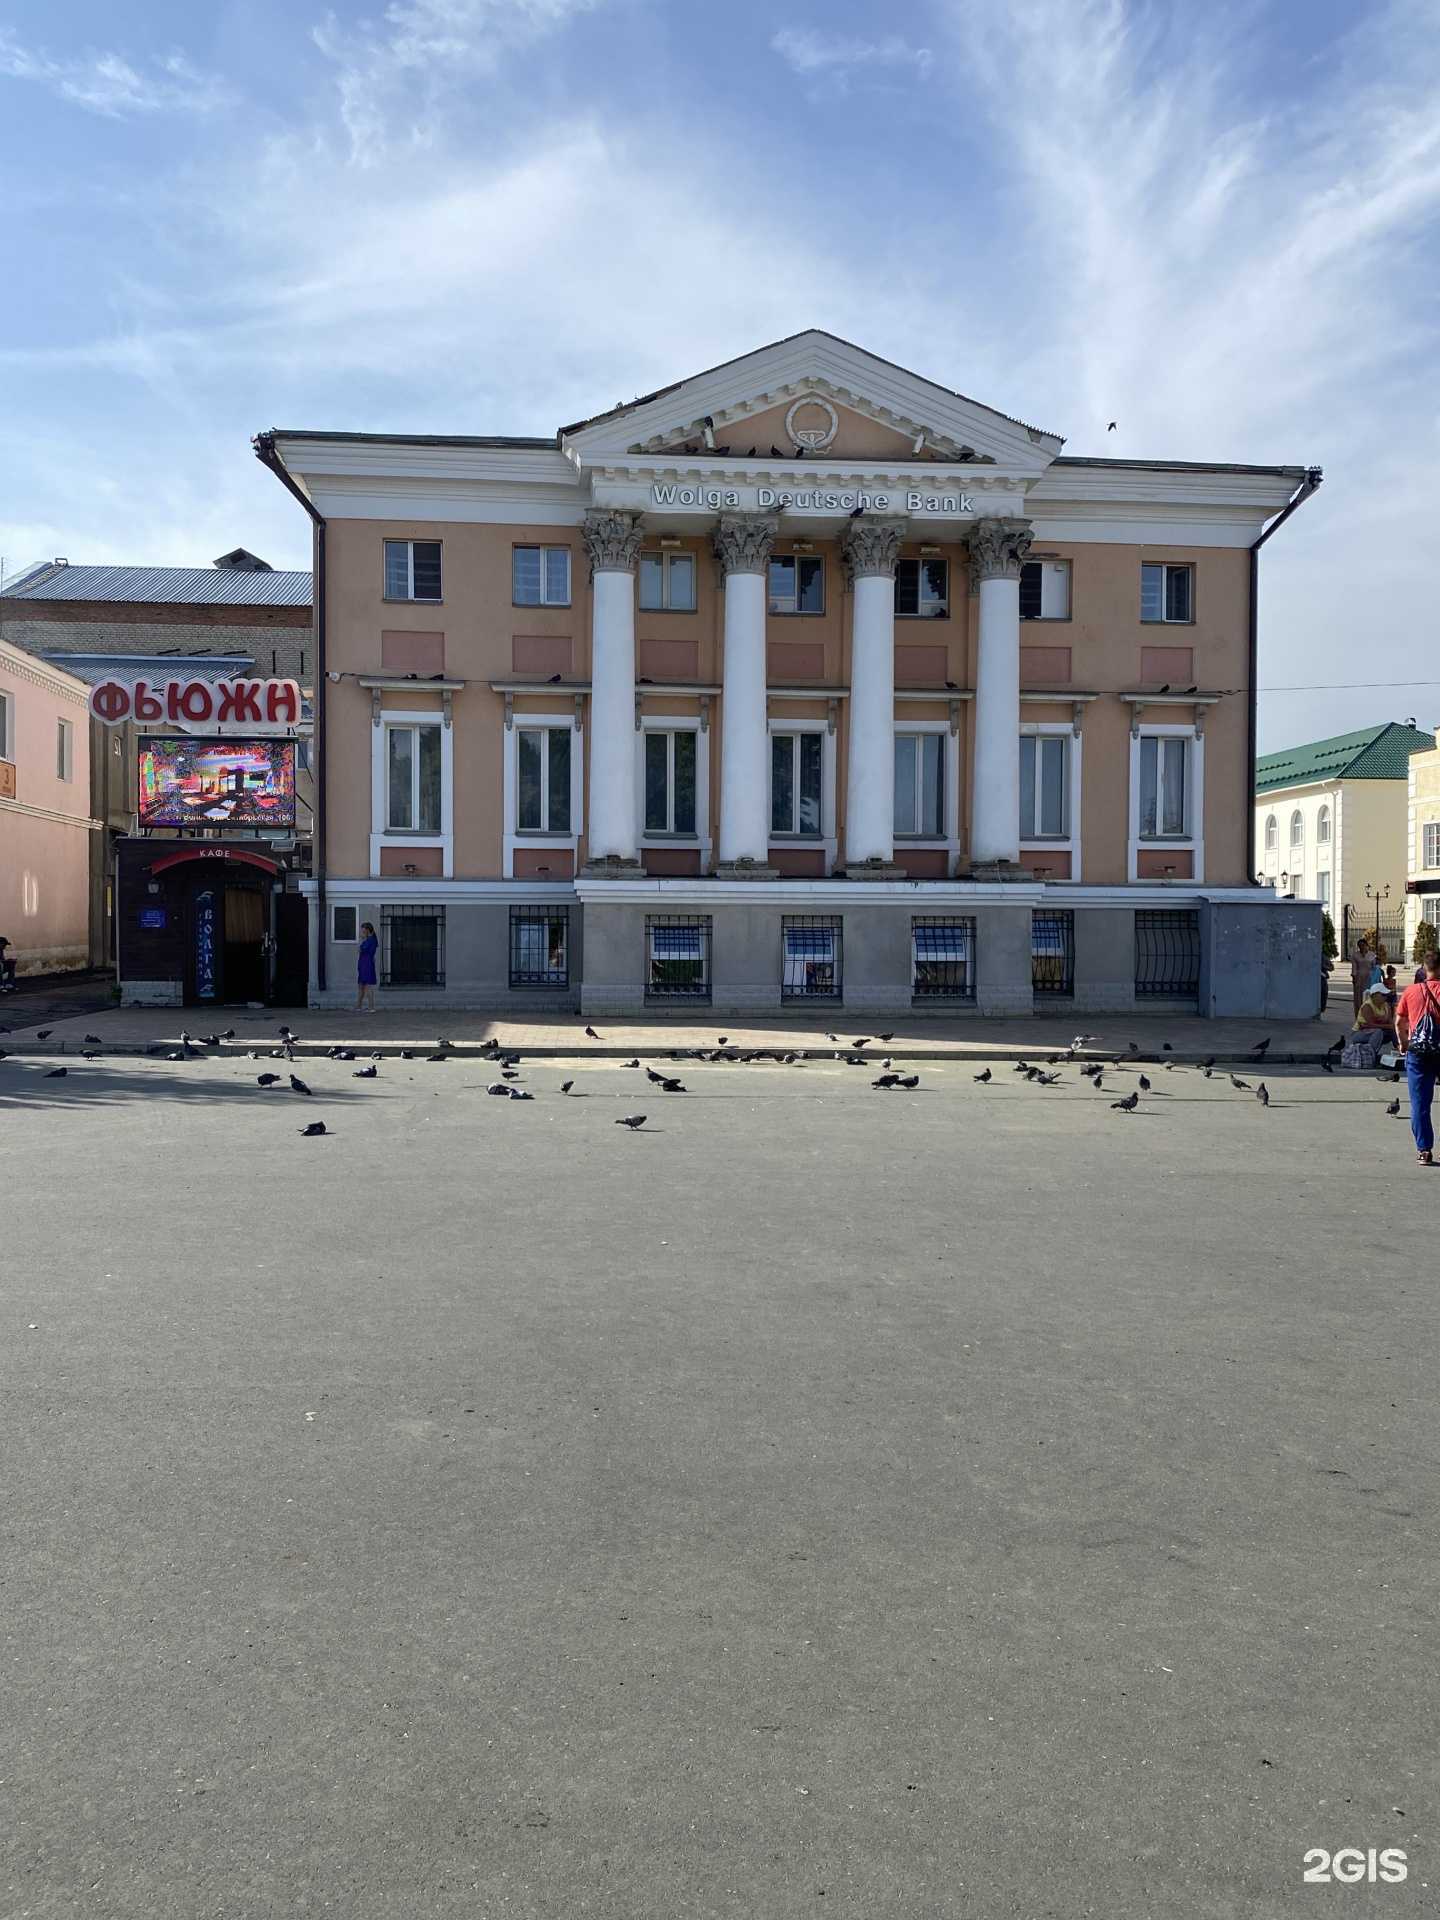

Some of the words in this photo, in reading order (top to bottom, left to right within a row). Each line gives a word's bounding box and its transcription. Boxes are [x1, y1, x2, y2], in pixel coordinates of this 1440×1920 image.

[653, 484, 739, 510] Wolga
[757, 488, 889, 511] Deutsche
[906, 491, 976, 512] Bank
[92, 682, 297, 722] ФЬЮЖН
[199, 849, 231, 858] КАФЕ
